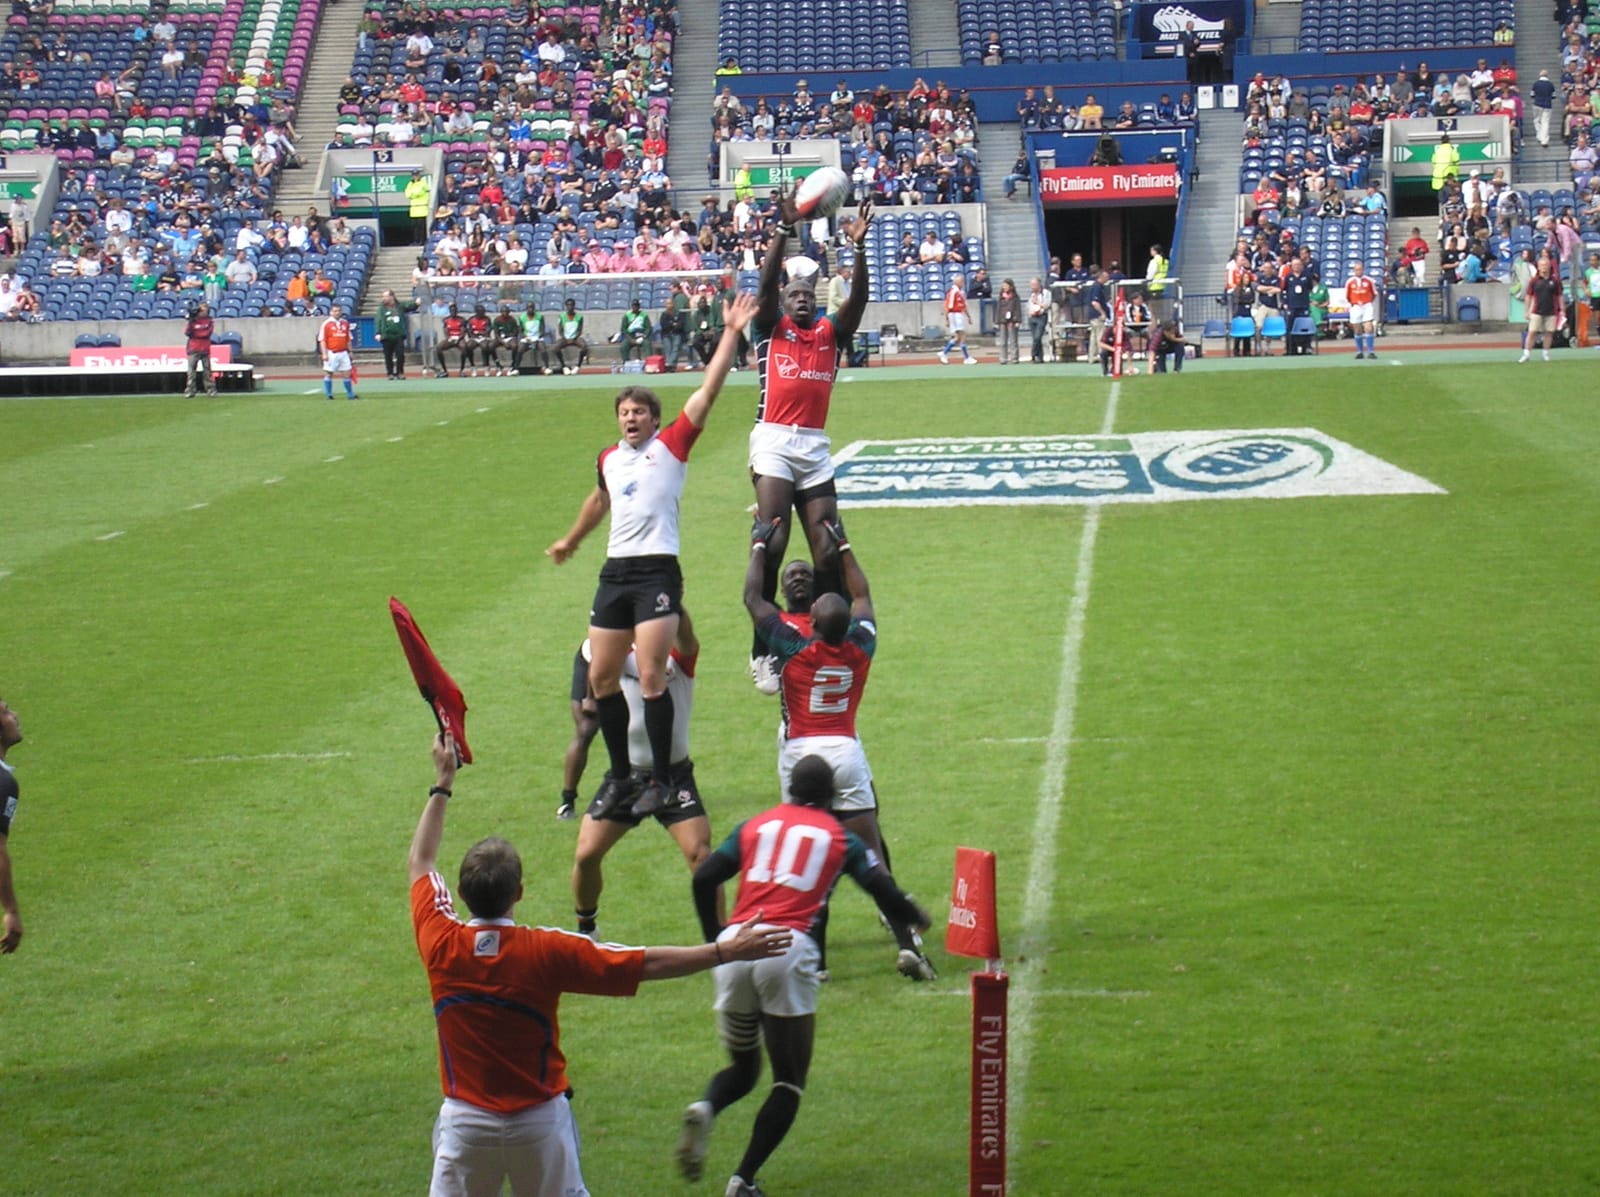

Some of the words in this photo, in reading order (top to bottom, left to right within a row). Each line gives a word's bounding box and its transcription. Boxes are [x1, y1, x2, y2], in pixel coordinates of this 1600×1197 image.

[1042, 177, 1060, 194] Fly
[1060, 176, 1104, 192] Emirates
[1113, 174, 1131, 192] Fly
[1131, 173, 1175, 189] Emirates
[894, 442, 1096, 454] SCOTLAND
[987, 457, 1120, 470] WORLD
[809, 665, 854, 714] 2
[746, 818, 833, 893] 10
[976, 1015, 1003, 1053] Fly
[980, 1057, 1004, 1160] Emirates
